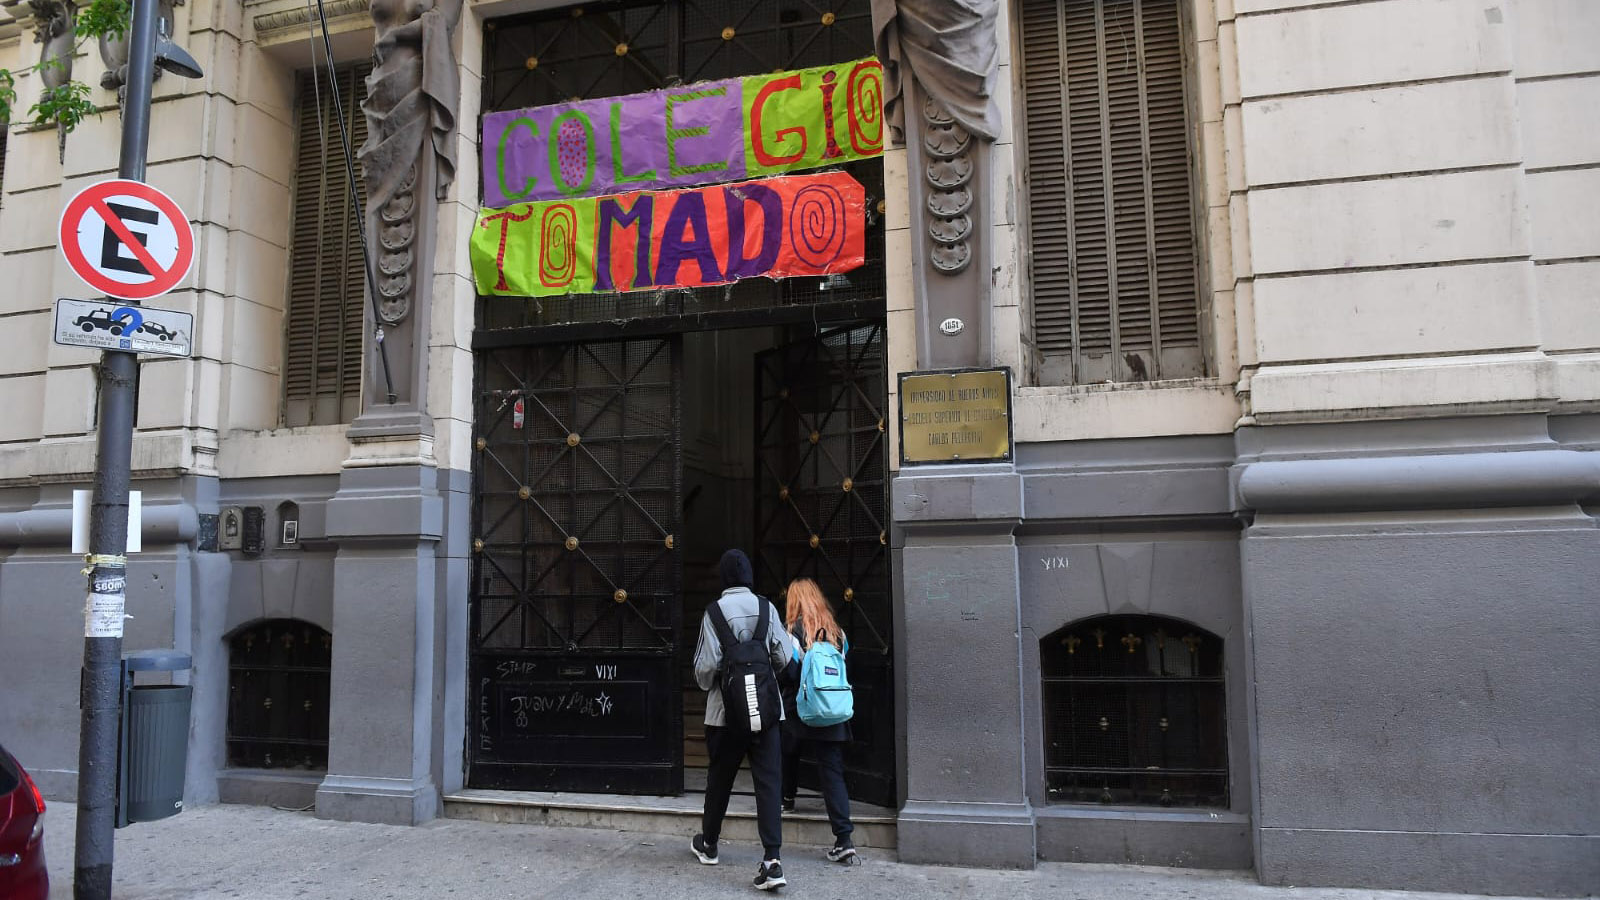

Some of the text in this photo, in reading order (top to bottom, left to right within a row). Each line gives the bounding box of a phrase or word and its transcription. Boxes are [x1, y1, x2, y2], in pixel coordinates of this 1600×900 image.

[496, 60, 883, 199] COLEGIO
[101, 201, 159, 276] E
[480, 183, 846, 291] TOMADO
[595, 664, 617, 680] VIXI
